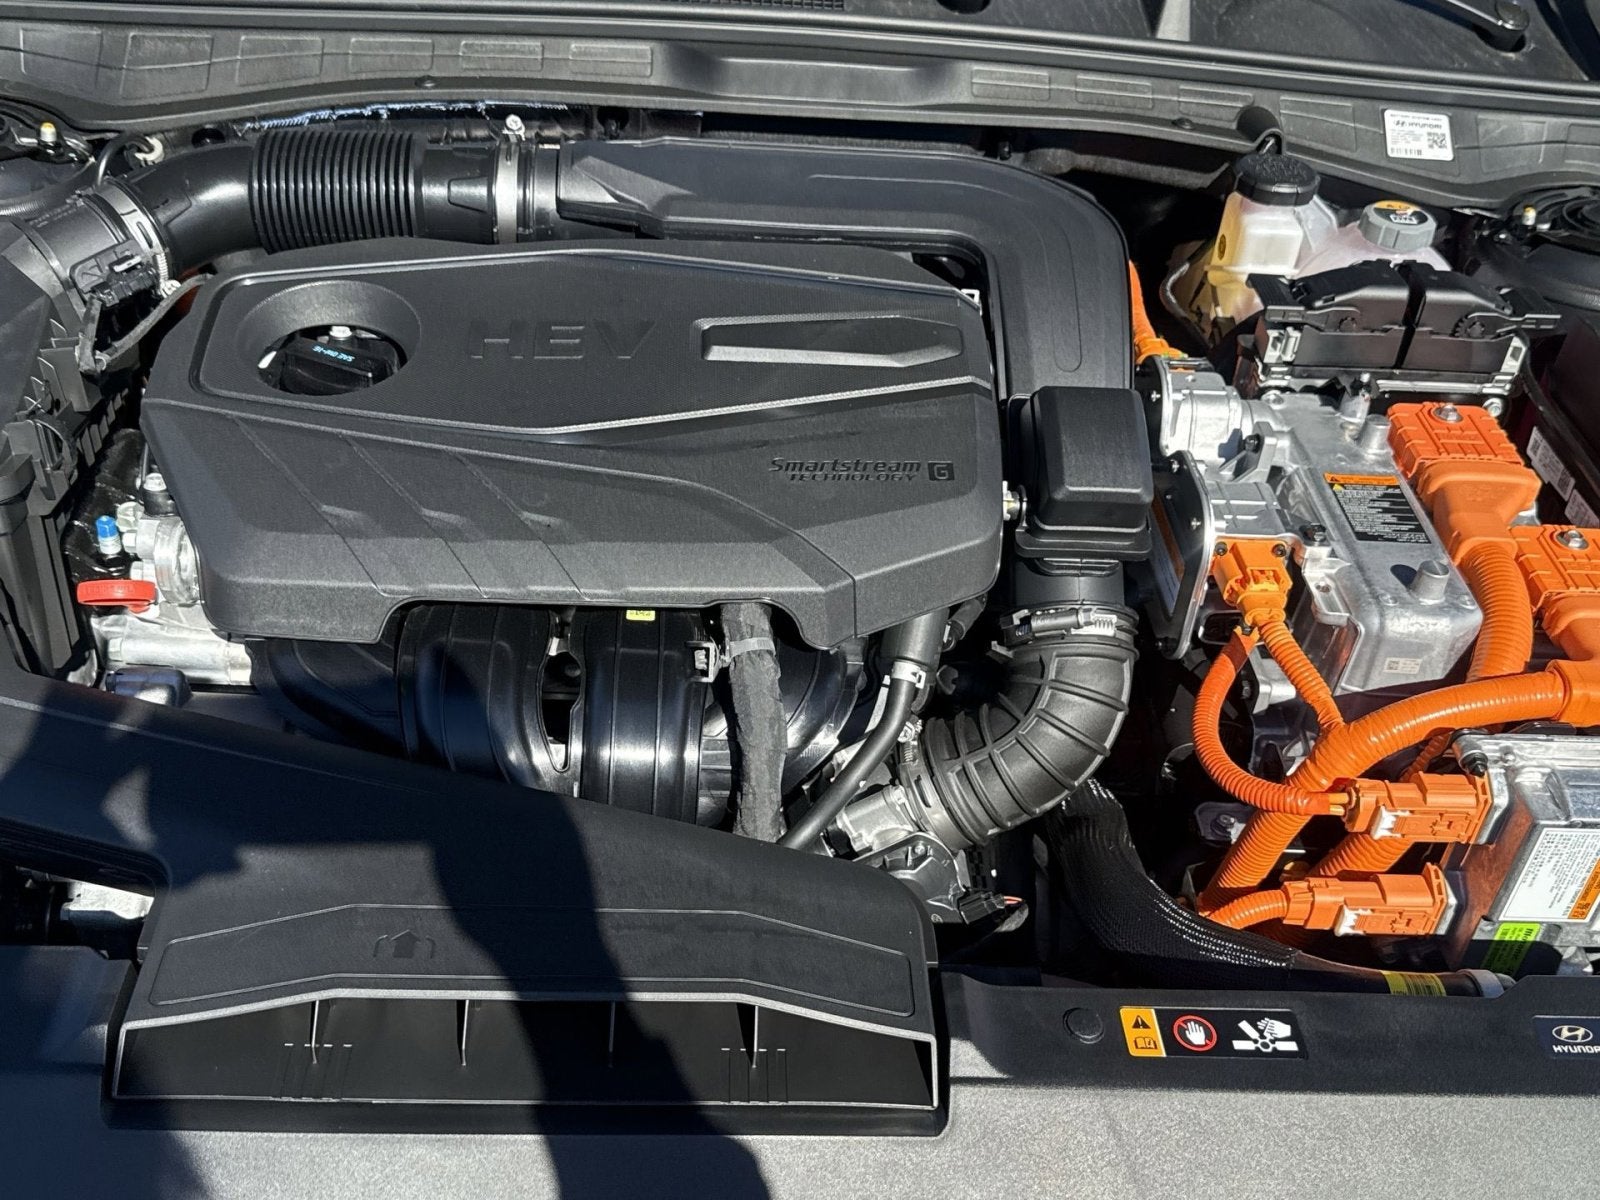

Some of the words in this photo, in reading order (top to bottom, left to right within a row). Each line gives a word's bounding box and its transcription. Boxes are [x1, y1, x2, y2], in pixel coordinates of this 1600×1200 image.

[466, 319, 656, 359] HEV
[769, 457, 921, 472] Smartstream
[932, 463, 951, 480] G
[788, 472, 917, 481] TECHNOLOGY
[1552, 1044, 1600, 1053] HYUNDA
